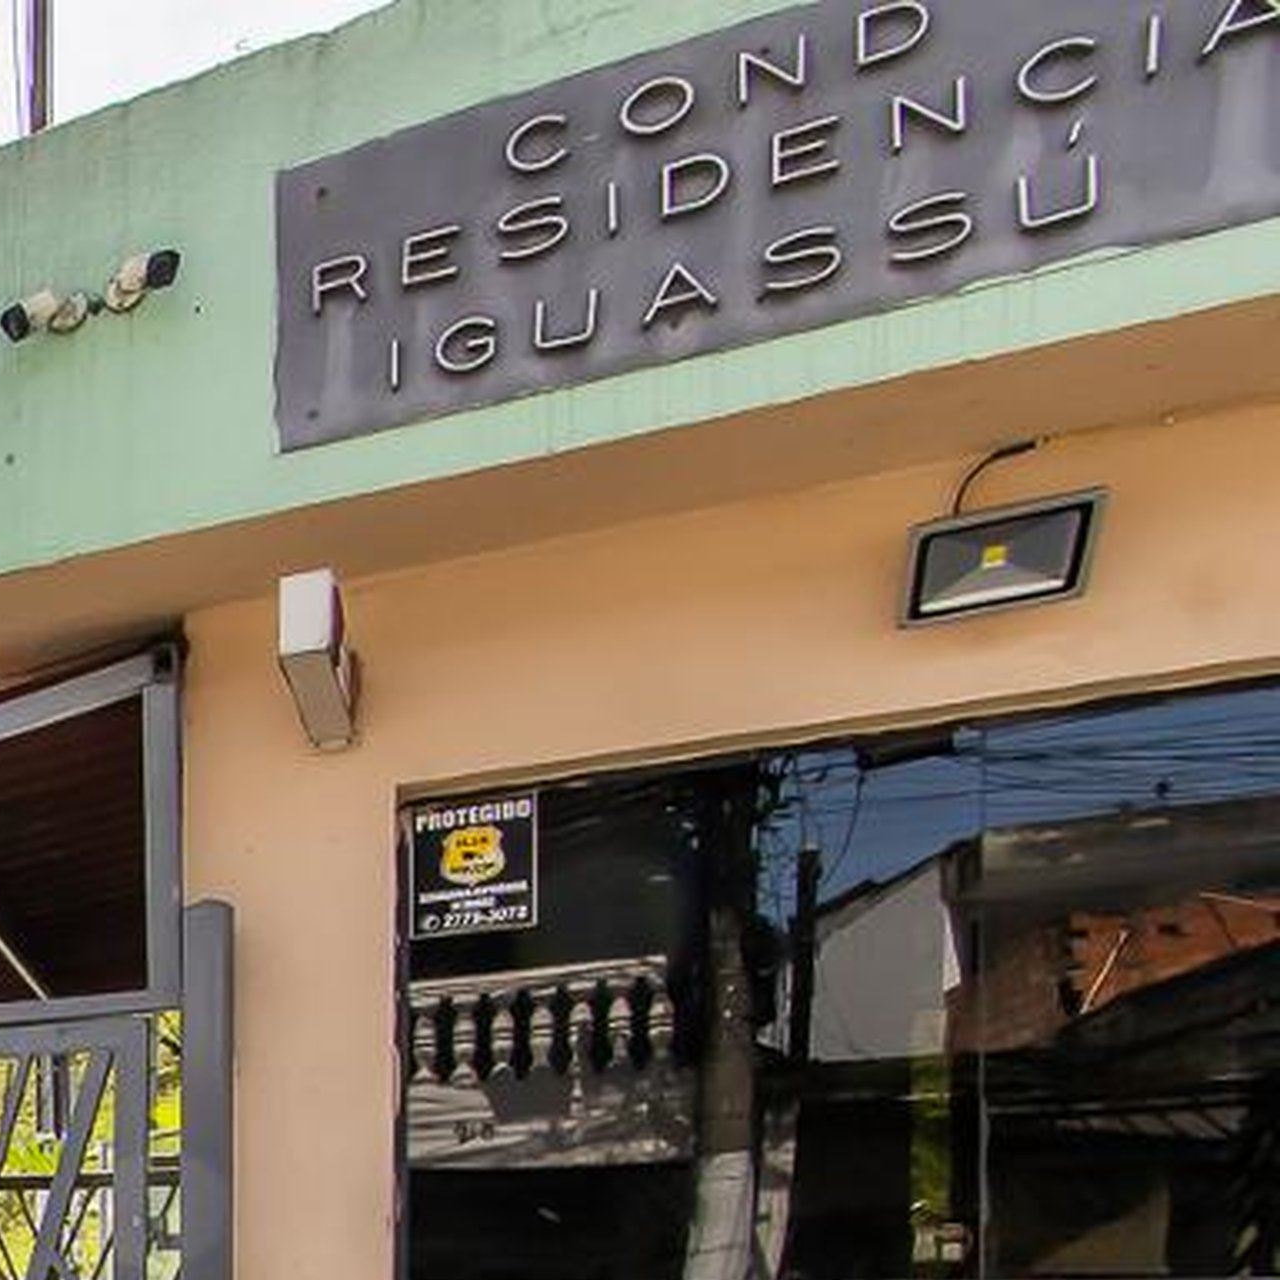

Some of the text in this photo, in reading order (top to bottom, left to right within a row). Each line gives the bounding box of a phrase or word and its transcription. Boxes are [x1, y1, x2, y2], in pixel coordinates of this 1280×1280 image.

[506, 0, 929, 172] COND
[390, 121, 1099, 388] IGUASSÚ
[415, 799, 532, 833] PROTEGIDO
